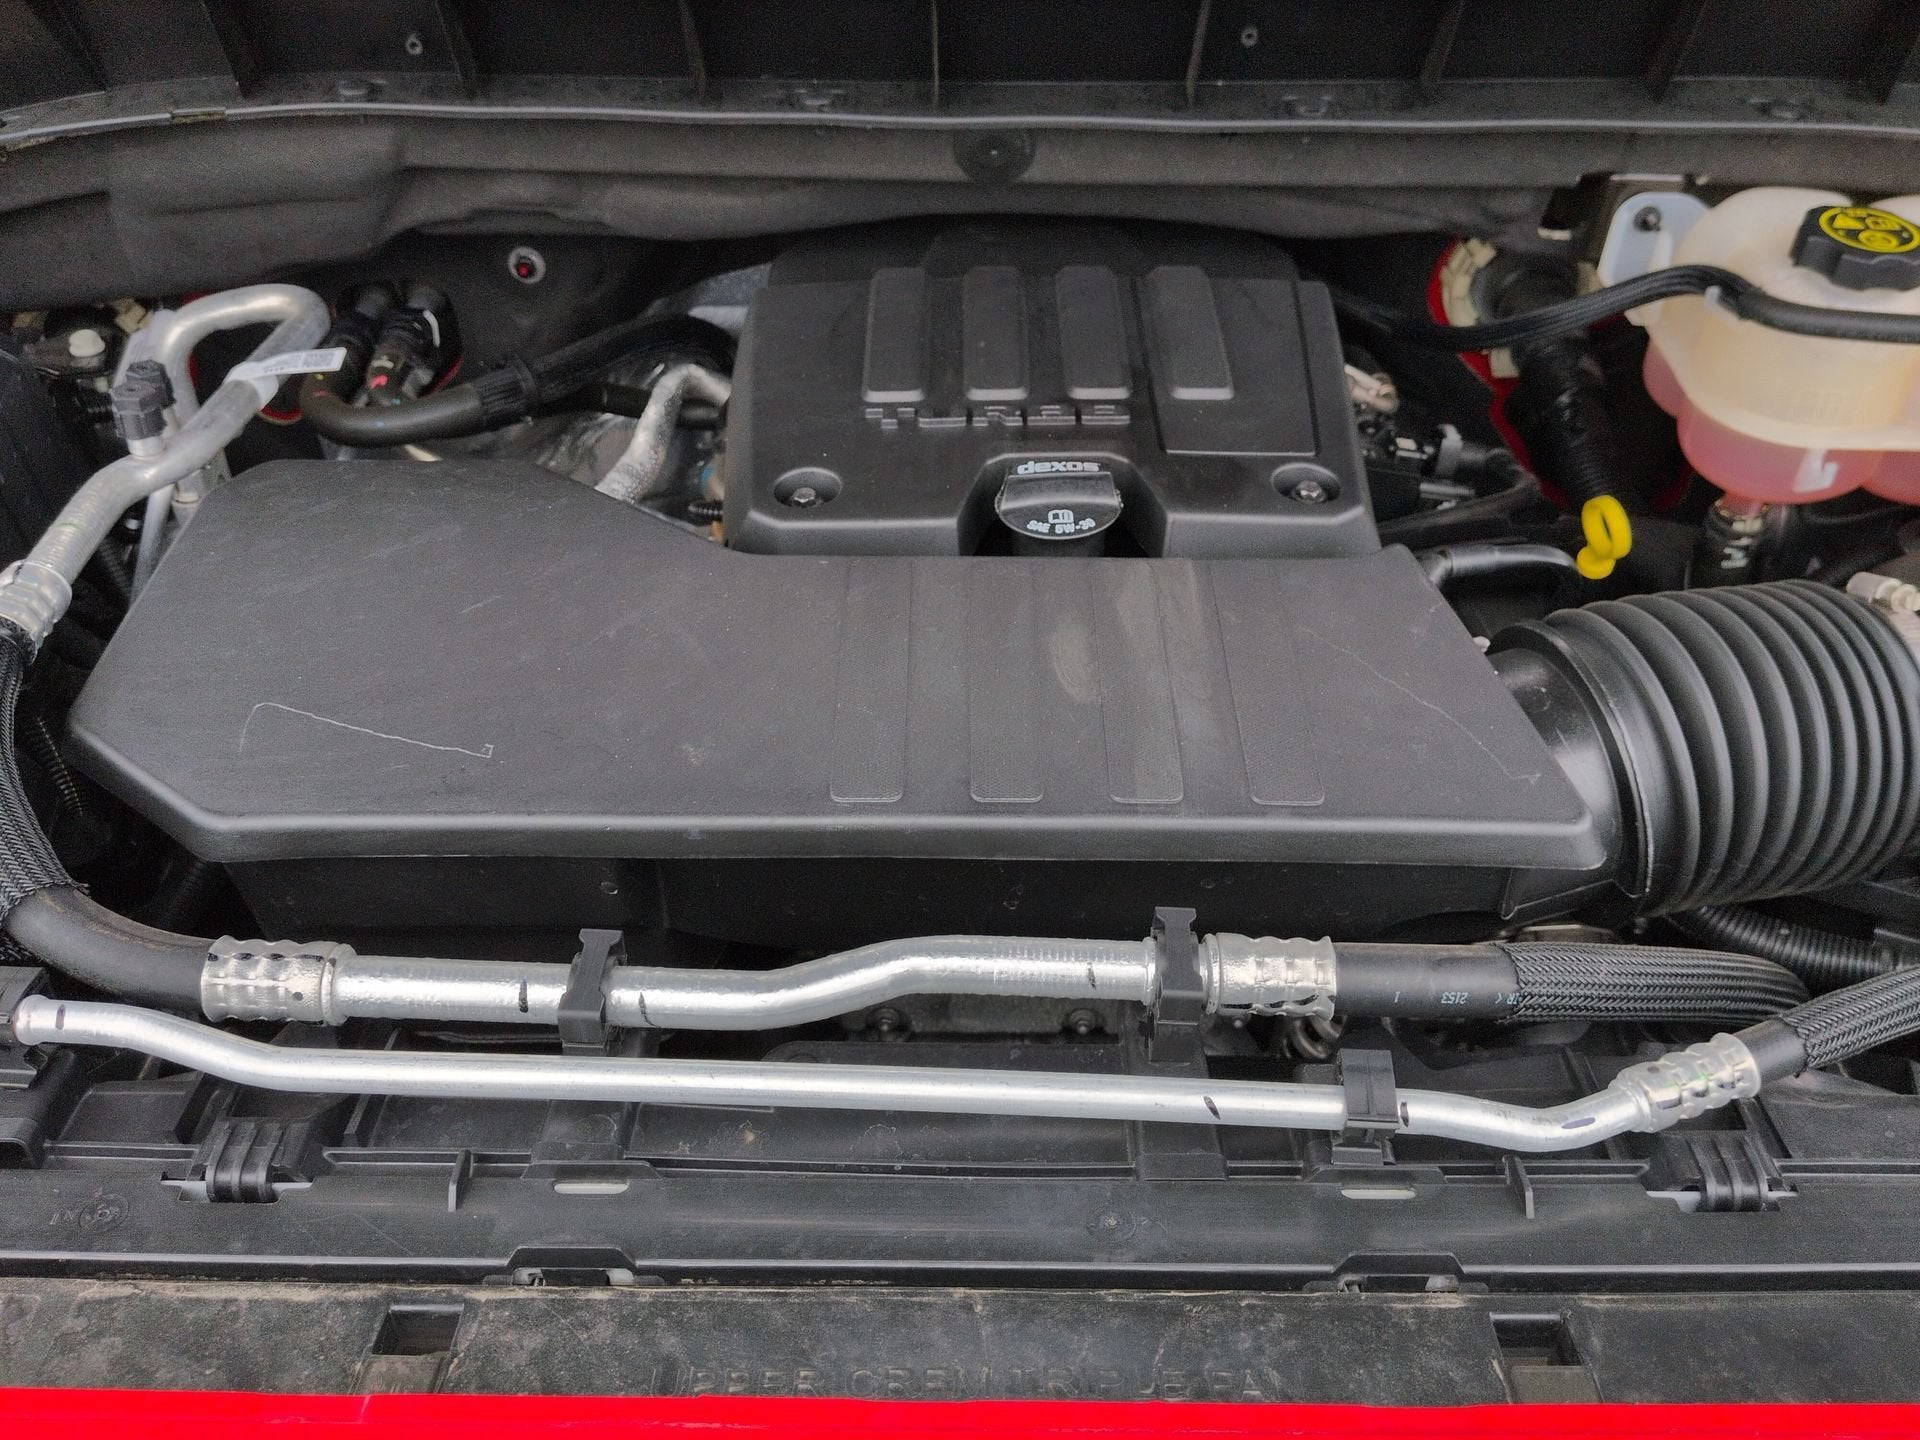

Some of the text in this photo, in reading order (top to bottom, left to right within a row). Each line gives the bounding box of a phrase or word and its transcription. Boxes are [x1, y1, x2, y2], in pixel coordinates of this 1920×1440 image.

[1017, 461, 1101, 475] dexos
[1027, 518, 1096, 534] SAE 5W-30
[1440, 991, 1469, 1004] 2153
[650, 1367, 820, 1397] UPPER
